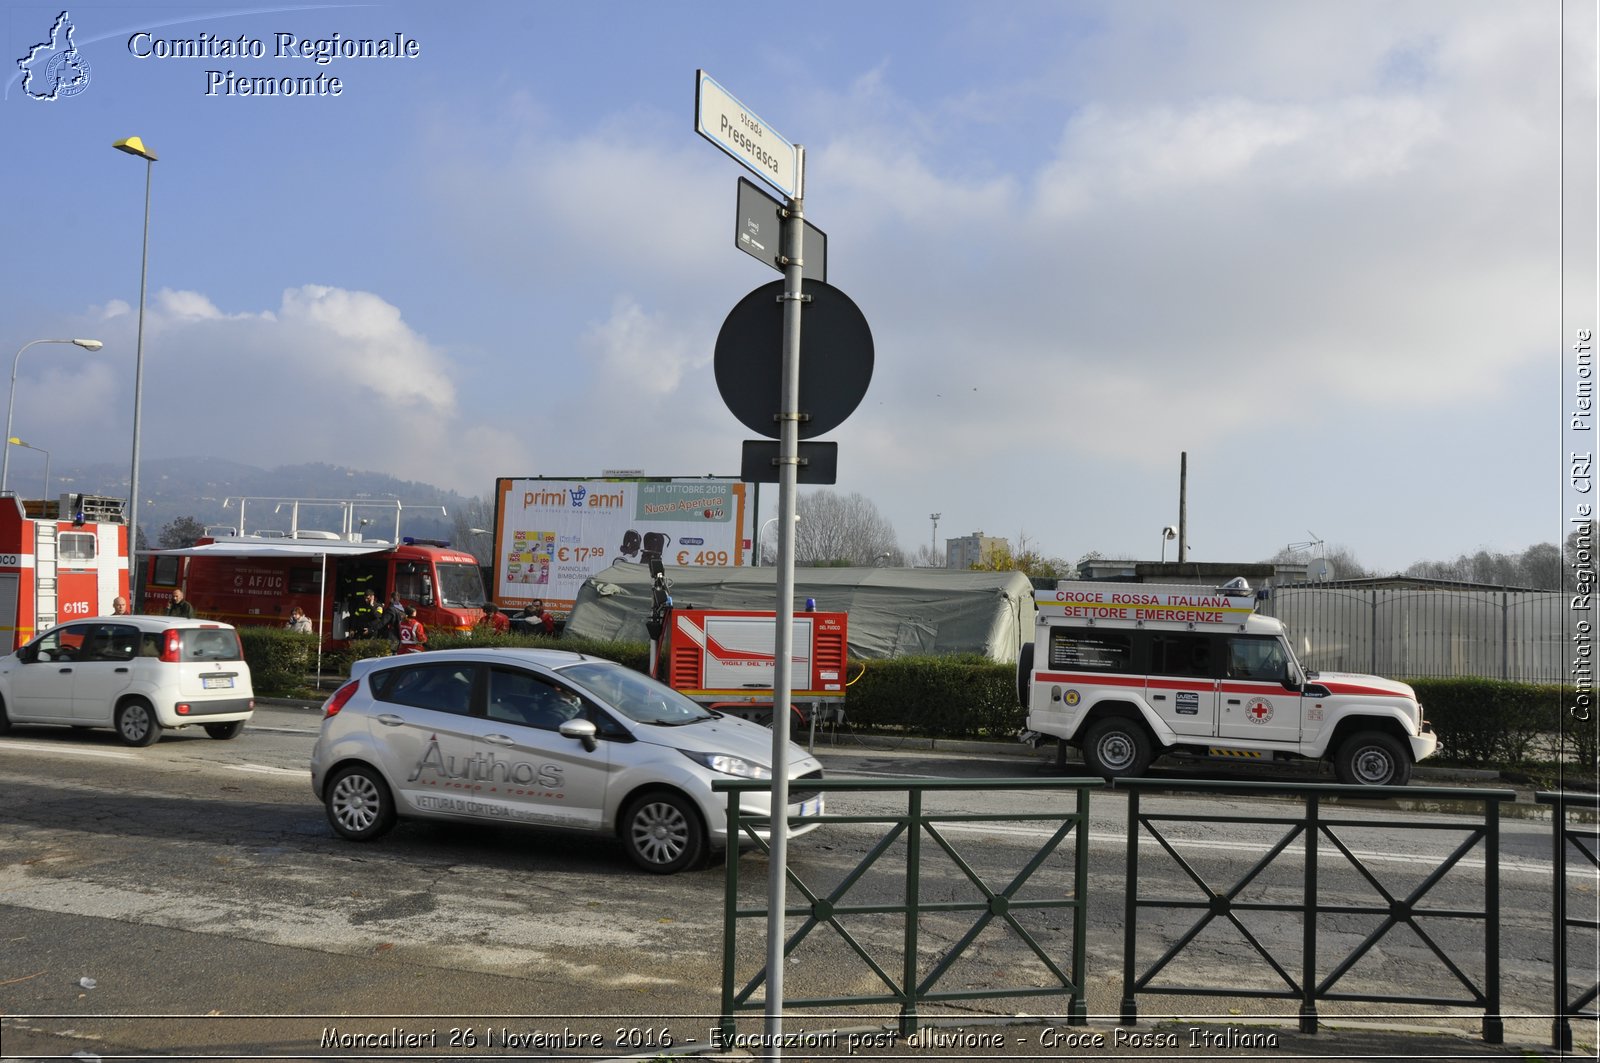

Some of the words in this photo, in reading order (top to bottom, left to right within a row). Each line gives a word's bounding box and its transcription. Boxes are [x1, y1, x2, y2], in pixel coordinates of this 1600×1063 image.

[740, 111, 763, 137] strada
[720, 113, 779, 174] Preserasca
[666, 485, 704, 494] OTTOBRE
[706, 486, 726, 495] 2016
[524, 488, 566, 510] primi
[588, 490, 624, 508] anni
[645, 502, 676, 514] Nuova
[679, 497, 722, 509] Apertura
[557, 547, 570, 561] €
[574, 547, 604, 562] 17,99
[677, 551, 689, 565] €
[694, 551, 728, 565] 499
[249, 575, 282, 588] AF/UC
[72, 602, 89, 613] 115
[1055, 591, 1103, 603] CROCE
[1112, 593, 1160, 605] ROSSA
[1167, 595, 1231, 608] ITALIANA
[1064, 606, 1127, 619] SETTORE
[1135, 609, 1223, 623] EMERGENZE
[407, 733, 564, 788] Authos
[507, 788, 565, 799] TORINO
[416, 795, 455, 810] VETTURA
[456, 800, 465, 811] DI
[467, 802, 510, 817] CORTESIA
